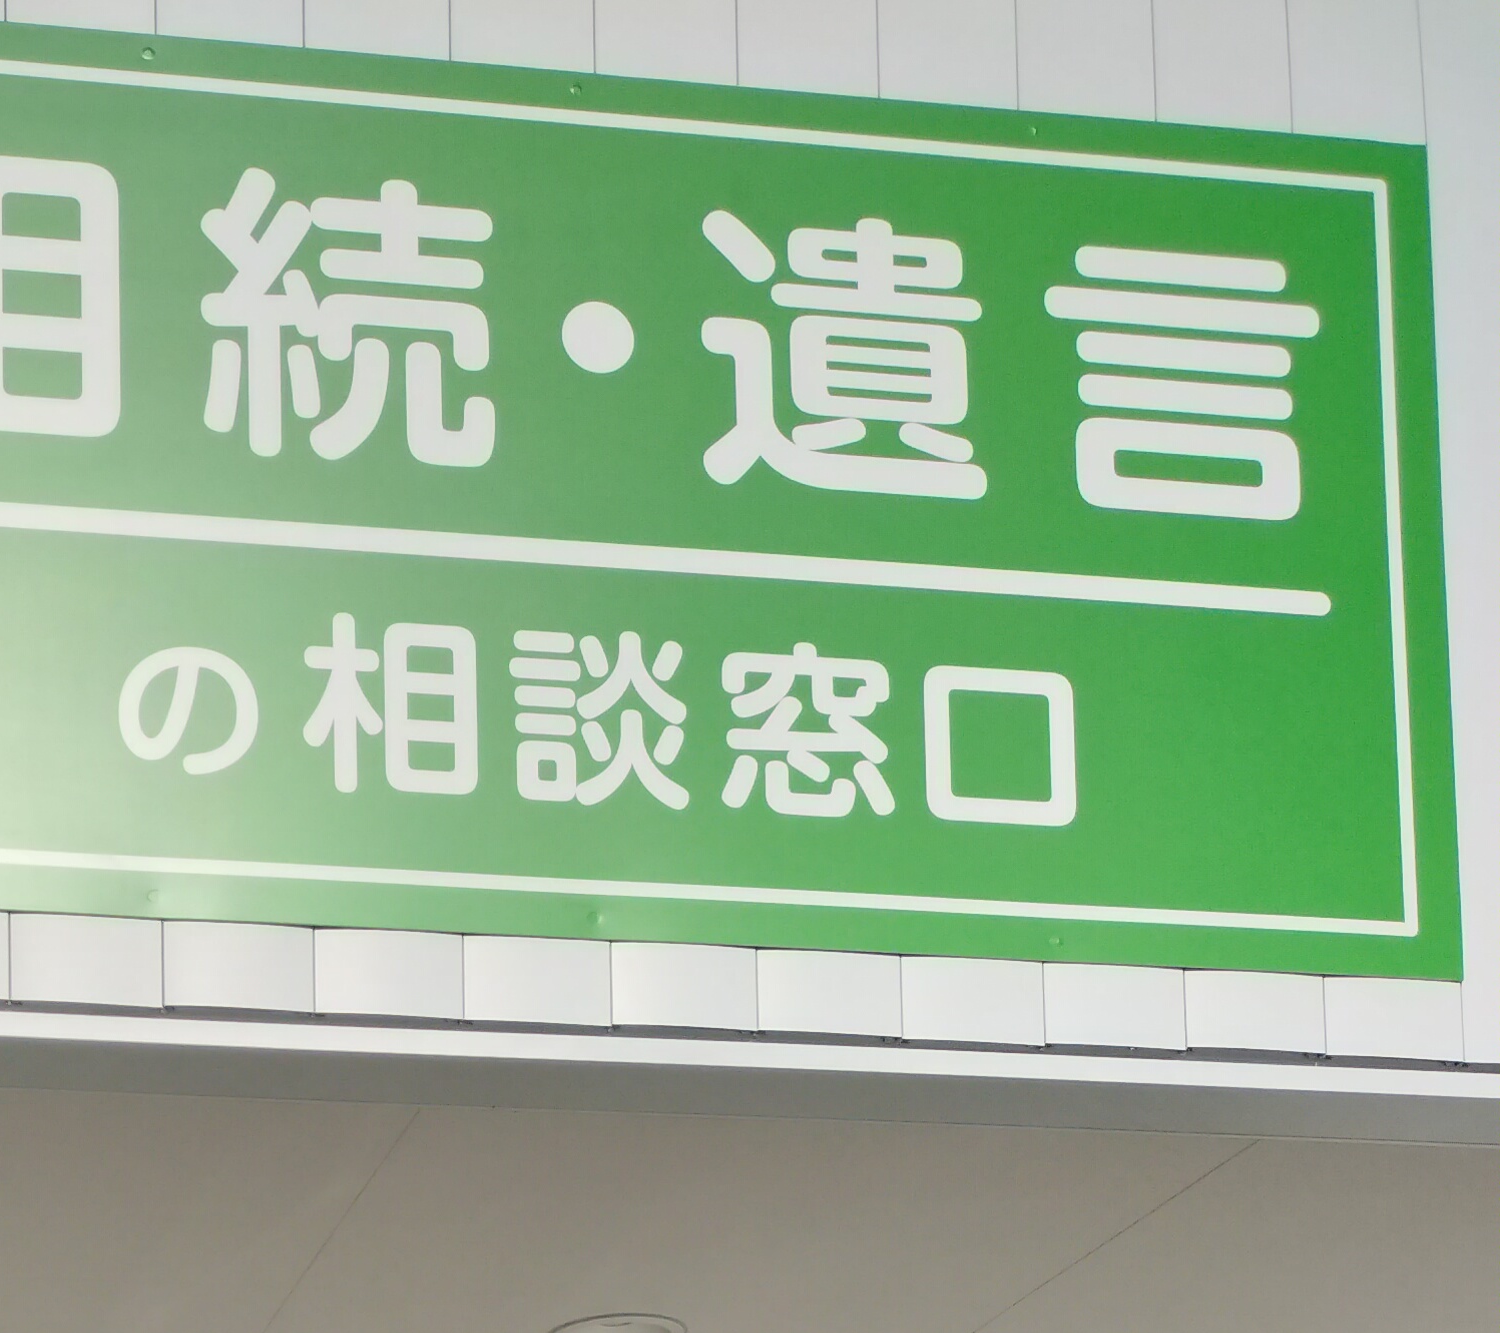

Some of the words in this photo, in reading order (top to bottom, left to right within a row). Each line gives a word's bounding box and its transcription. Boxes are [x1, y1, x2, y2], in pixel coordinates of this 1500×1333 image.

[118, 613, 1078, 827] の相談窓口
